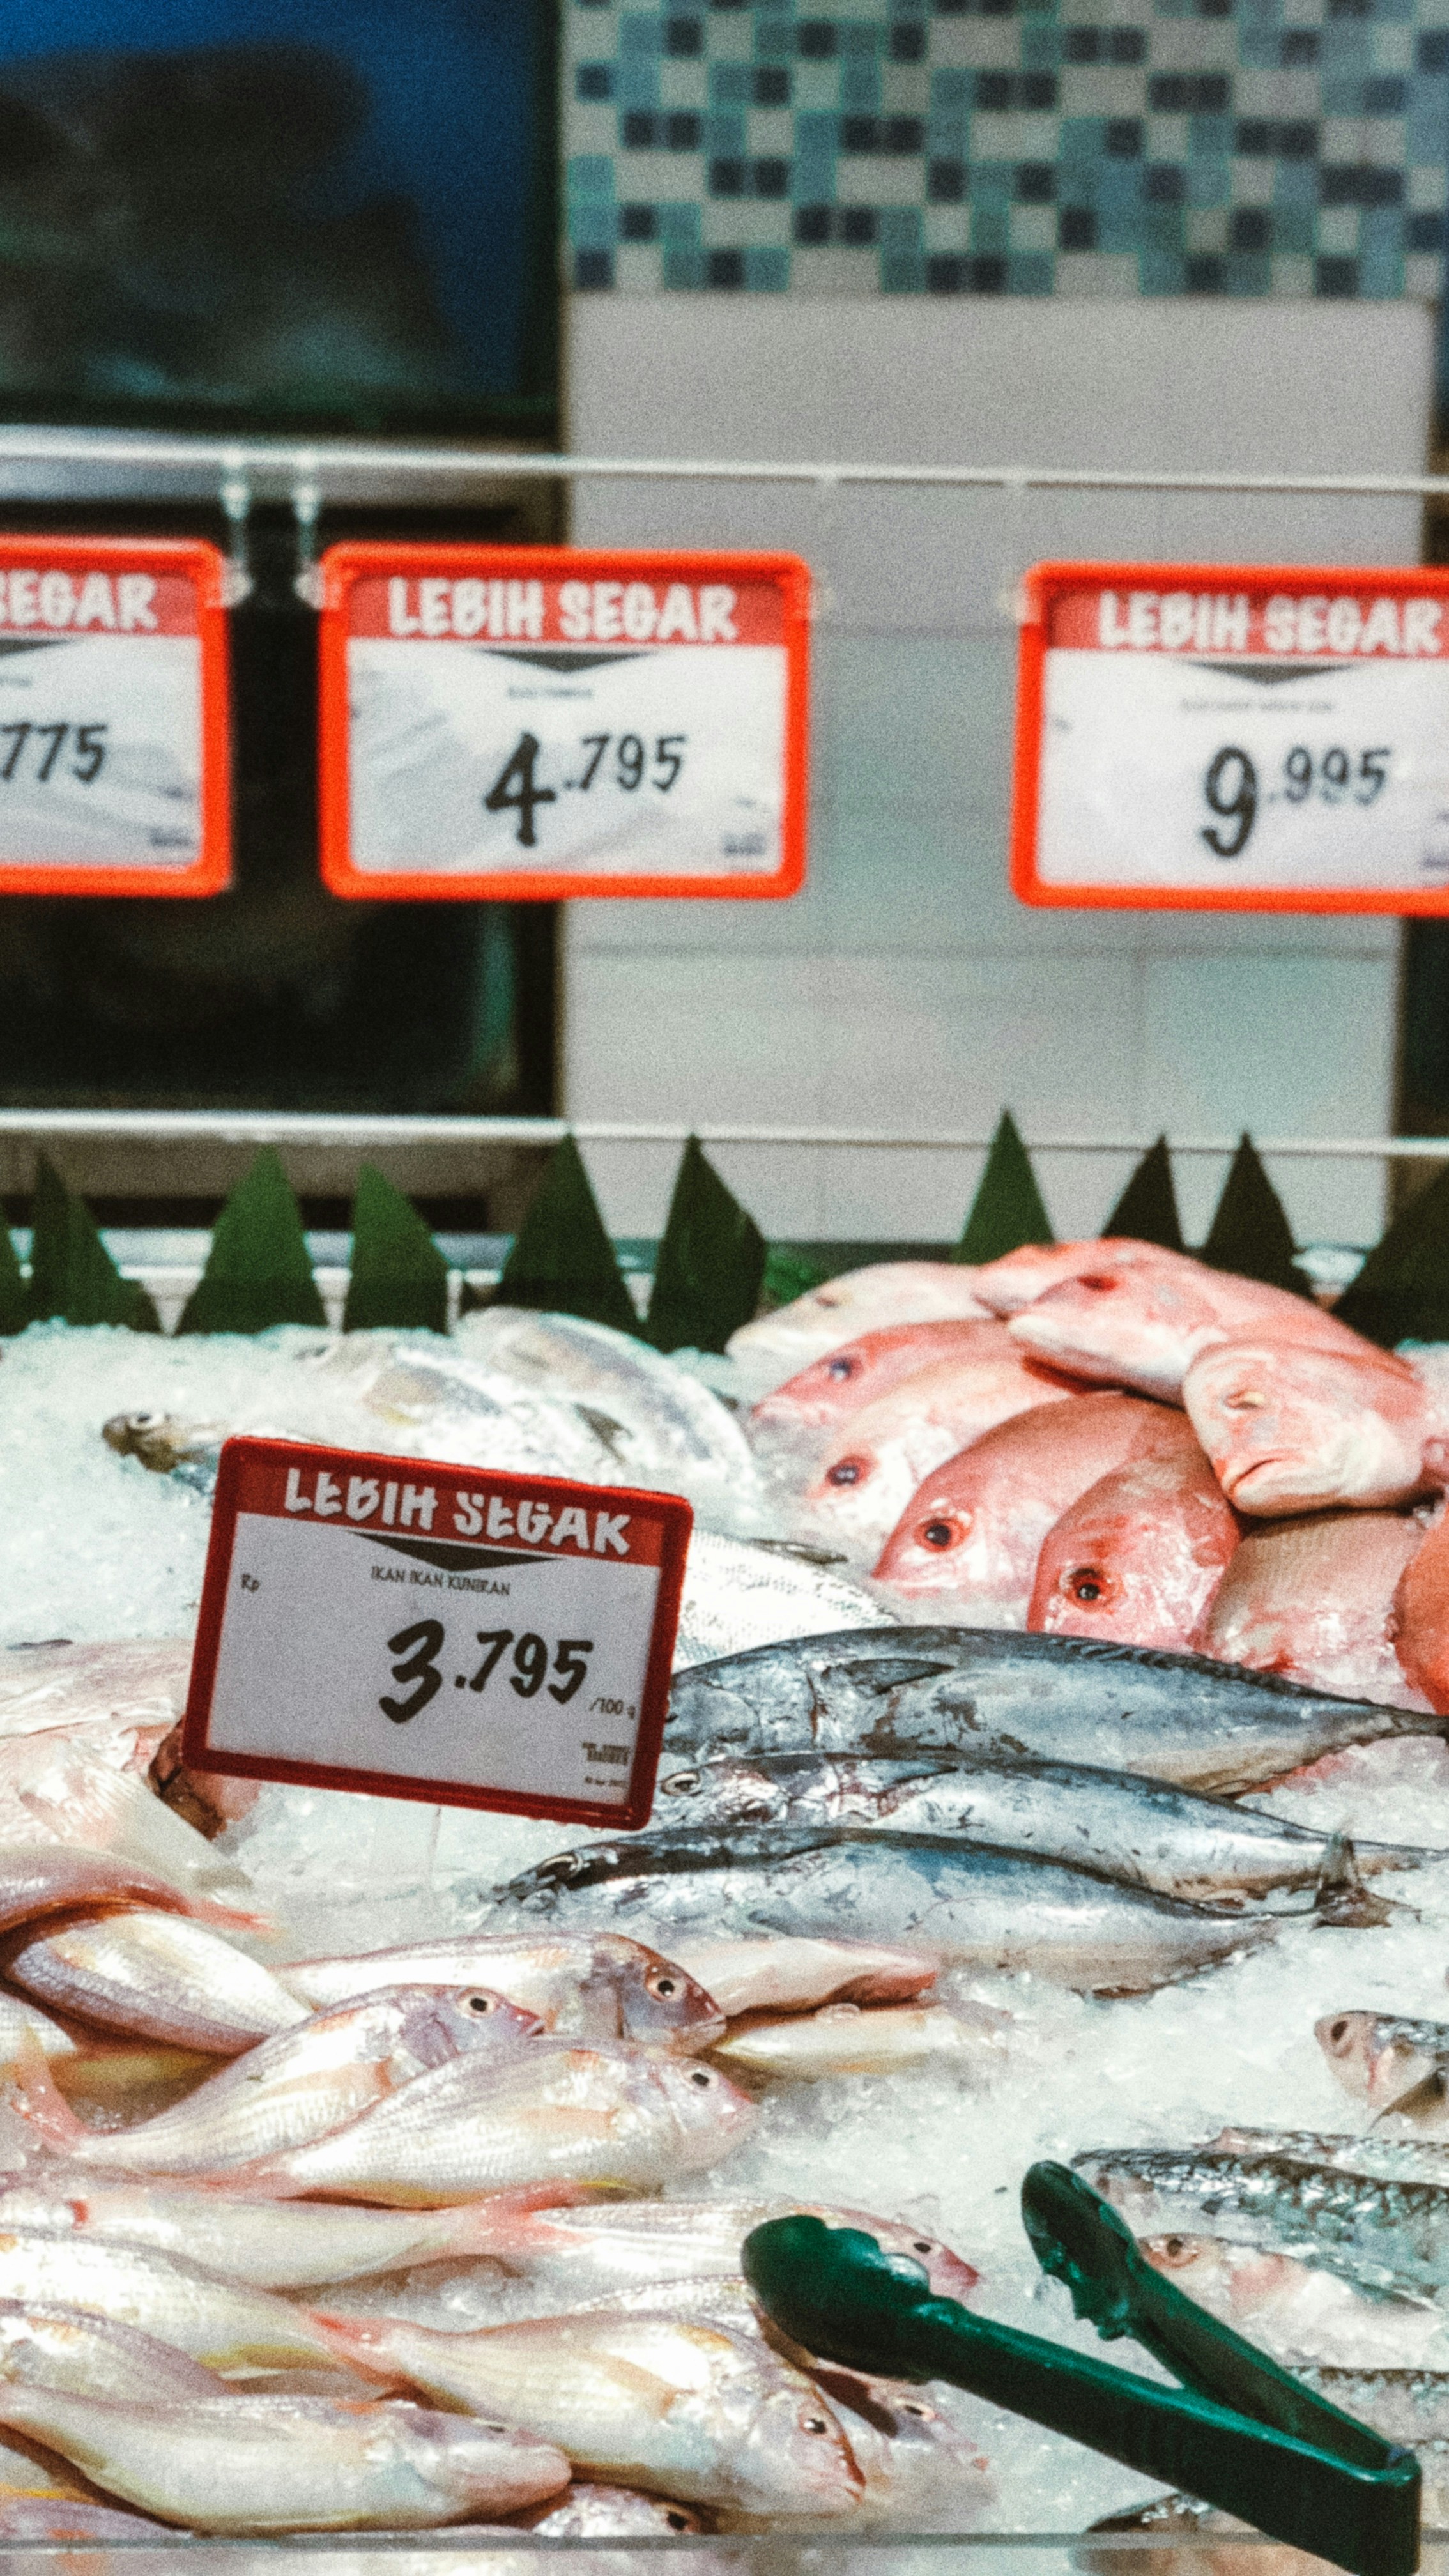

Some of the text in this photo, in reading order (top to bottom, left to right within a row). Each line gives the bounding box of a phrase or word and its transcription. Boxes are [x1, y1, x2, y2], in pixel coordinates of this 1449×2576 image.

[0, 569, 158, 630] EGAR
[388, 576, 739, 641] LEBIH SEGAR
[1099, 590, 1443, 655] LEBIH SEGAR
[484, 728, 688, 848] 4.795
[1198, 744, 1392, 859] 9.995
[284, 1468, 438, 1531] LEBIH
[241, 1573, 260, 1593] Rp
[371, 1565, 405, 1583] IKAN
[410, 1570, 443, 1588] IKAN
[378, 1619, 594, 1724] 3.795
[588, 1697, 624, 1715] /100
